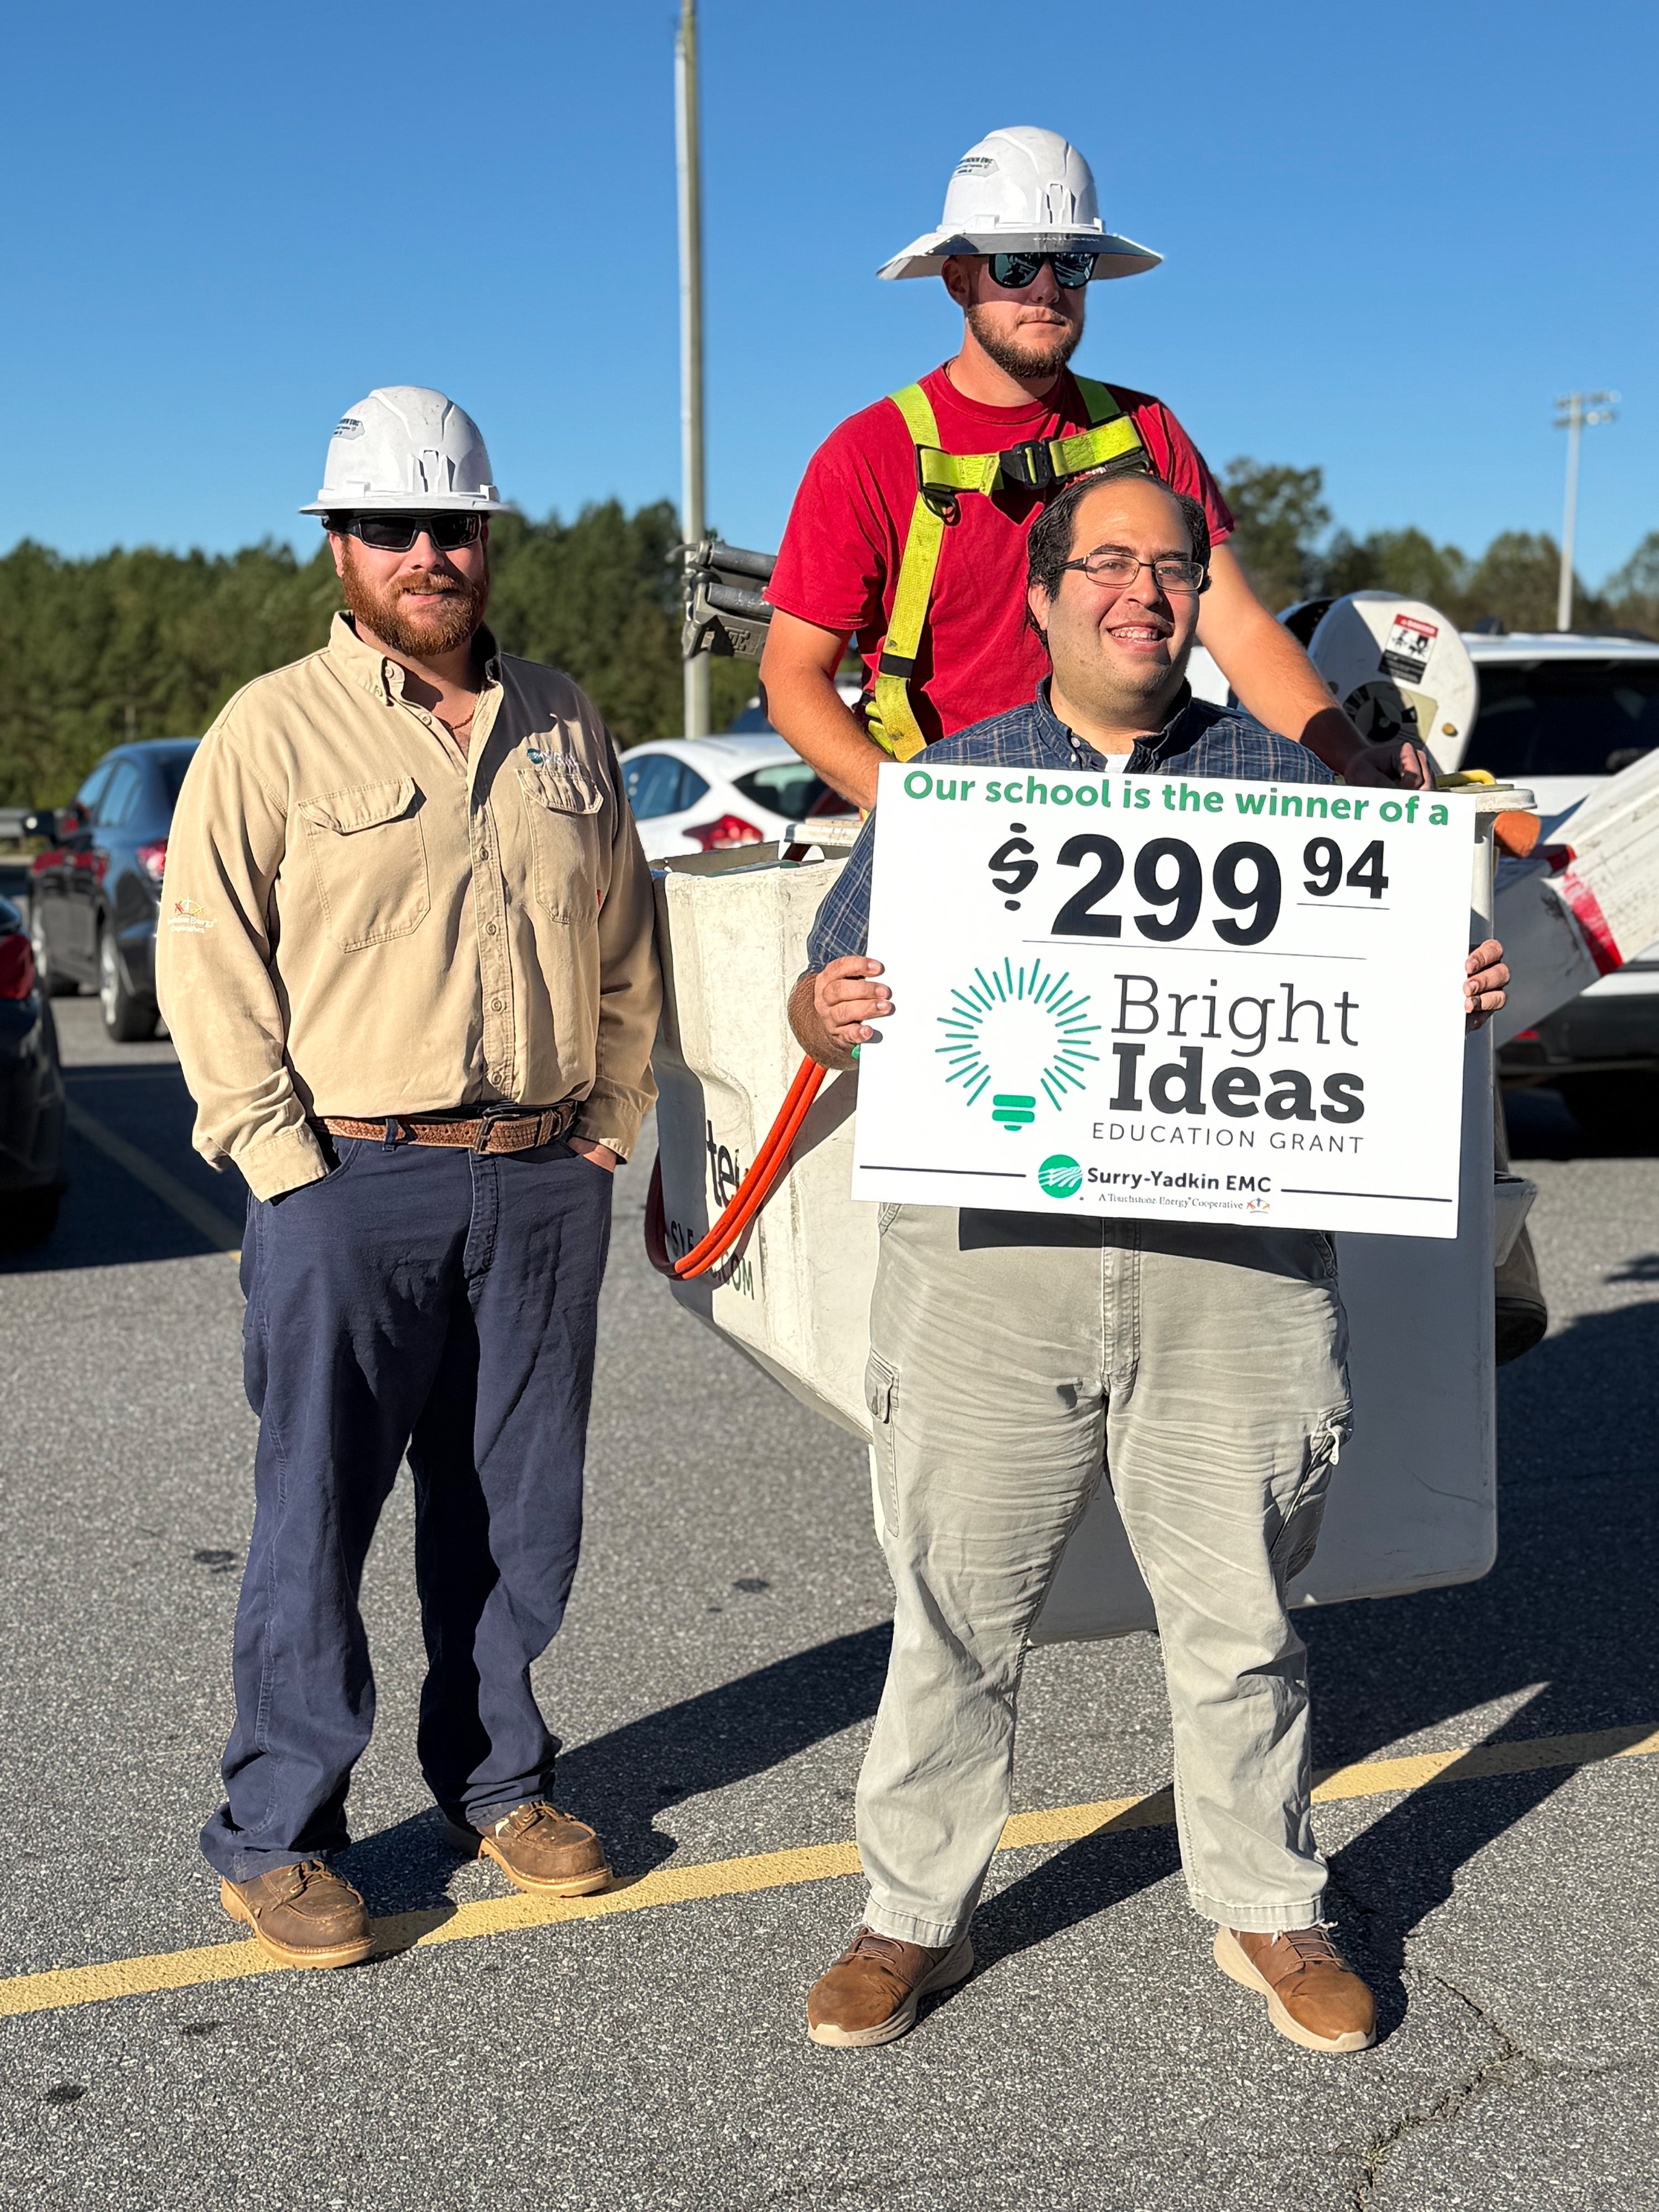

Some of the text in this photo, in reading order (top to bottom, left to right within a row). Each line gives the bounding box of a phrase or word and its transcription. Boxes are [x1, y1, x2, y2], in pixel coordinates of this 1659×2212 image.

[904, 770, 1448, 826] Our school is the winner of a
[1303, 837, 1389, 899] 94
[1111, 974, 1359, 1057] Bright
[1109, 1042, 1365, 1124] Ideas
[1093, 1123, 1363, 1154] EDUCATION GRANT
[1087, 1167, 1271, 1193] Surry-Yadkin EMC
[1098, 1193, 1106, 1202] A
[1192, 1198, 1243, 1209] Cooperative
